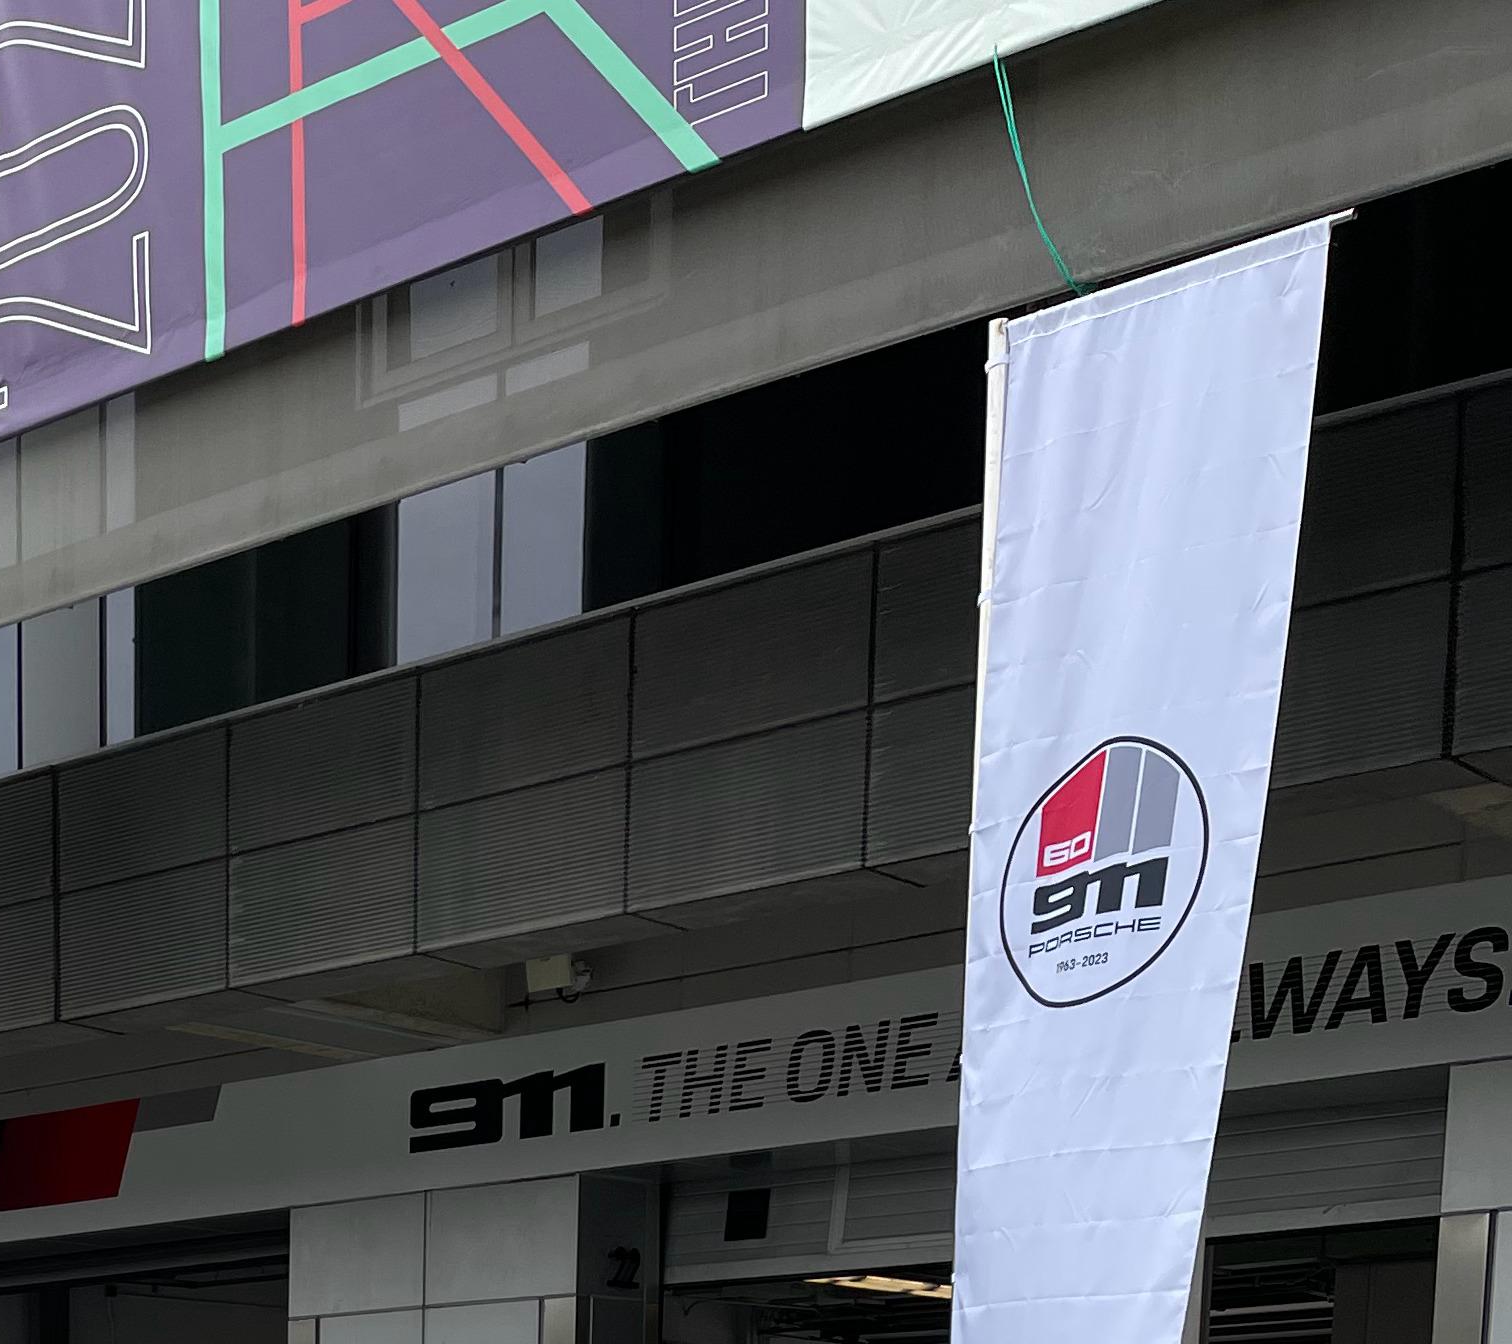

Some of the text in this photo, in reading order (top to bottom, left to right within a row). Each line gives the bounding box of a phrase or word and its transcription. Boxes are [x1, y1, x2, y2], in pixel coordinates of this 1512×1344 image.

[673, 0, 769, 127] TH
[1043, 831, 1092, 867] 60
[1031, 856, 1170, 934] 911
[1029, 916, 1161, 958] PORSCHE
[1056, 952, 1109, 974] 1963-2023
[641, 1038, 773, 1123] THE
[788, 1012, 939, 1103] ONE
